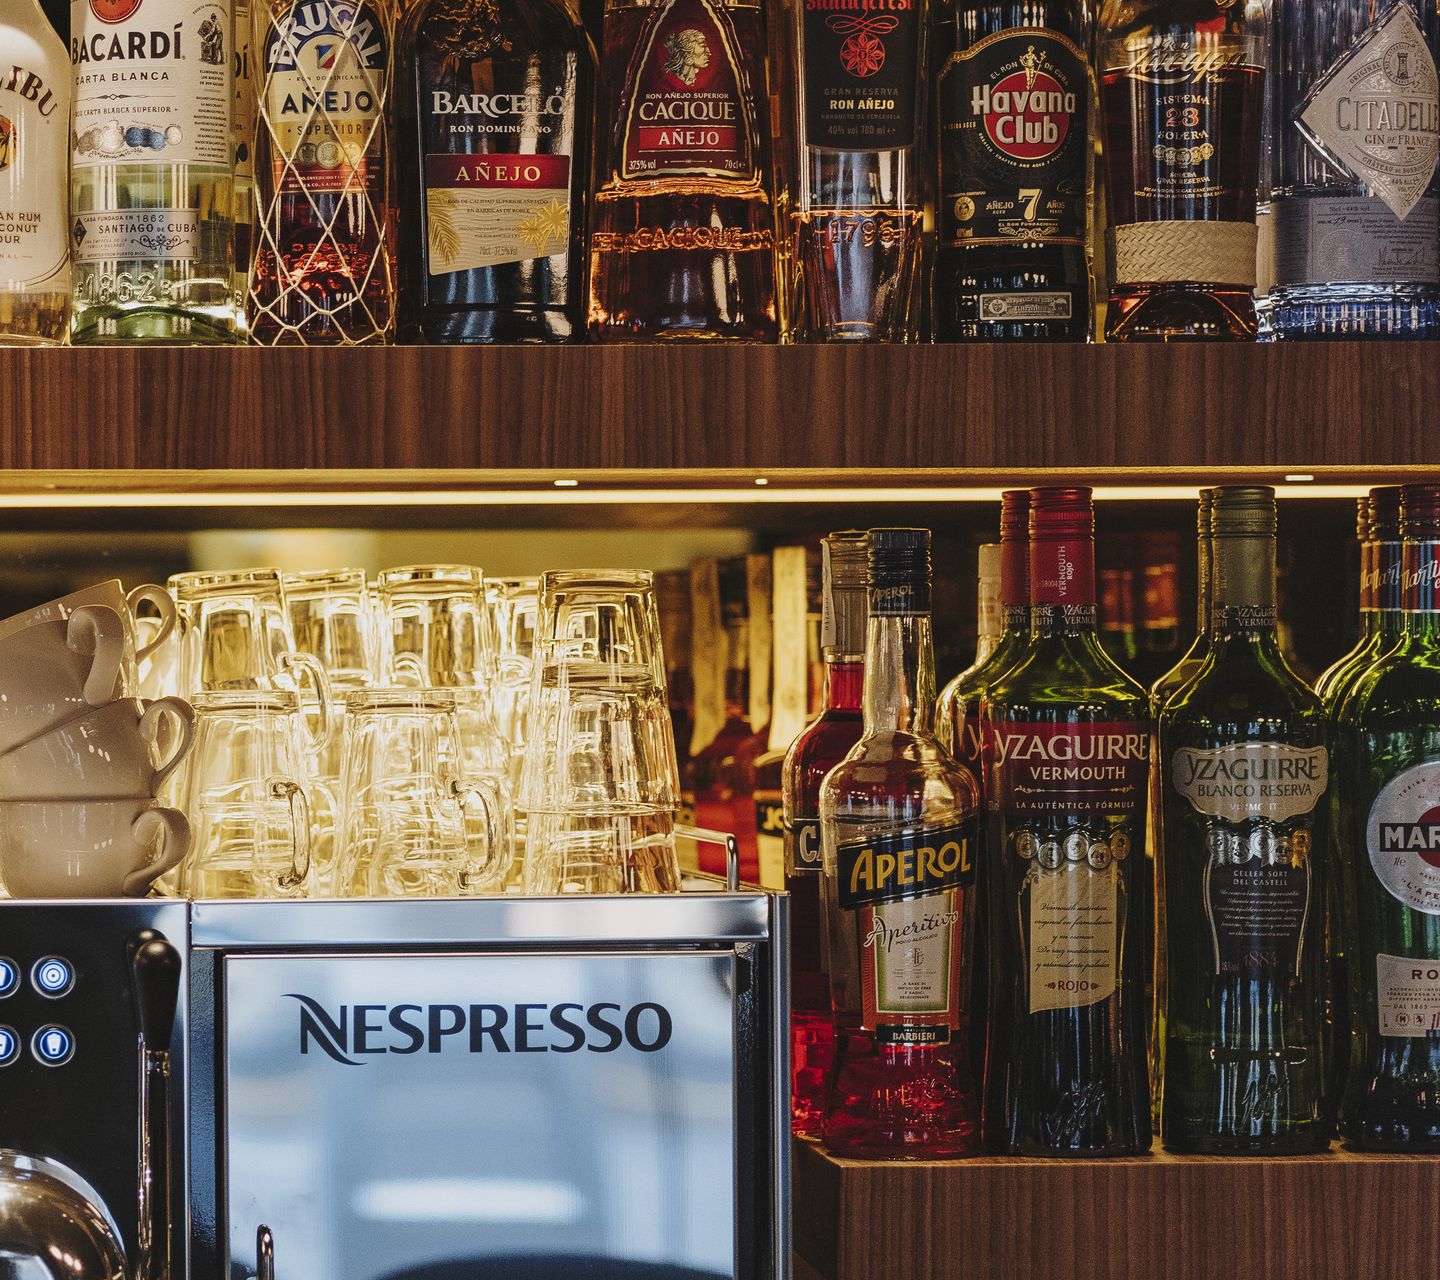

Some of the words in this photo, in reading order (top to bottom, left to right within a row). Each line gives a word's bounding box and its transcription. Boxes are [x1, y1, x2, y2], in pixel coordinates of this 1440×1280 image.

[72, 21, 183, 66] BACARDÍ
[269, 2, 380, 67] BRUGAL
[75, 73, 107, 87] CARTA
[112, 71, 170, 83] BLANCA
[281, 85, 374, 114] AÑEJO
[646, 92, 661, 100] RON
[664, 91, 692, 100] AÑEJO
[829, 99, 855, 110] RON
[857, 97, 896, 110] AÑEJO
[971, 83, 1077, 116] Havana
[639, 101, 736, 121] CACIQUE
[1165, 107, 1199, 128] 23
[450, 124, 474, 134] RON
[658, 128, 721, 146] AÑEJO
[995, 115, 1059, 144] Club
[1364, 134, 1386, 145] GIN
[456, 161, 541, 182] AÑEJO
[985, 200, 1015, 211] AÑEJO
[1017, 187, 1043, 222] 7
[18, 213, 41, 223] RUM
[136, 214, 165, 224] 1862
[99, 224, 154, 235] SANTIAGO
[167, 221, 198, 233] CUBA
[1058, 545, 1066, 597] VERMOUTH
[1066, 562, 1074, 580] ROJO
[993, 729, 1149, 768] YZAGUIRRE
[1030, 765, 1126, 781] VERMOUTH
[1184, 754, 1321, 786] YZAGUIRRE
[1198, 784, 1256, 798] BLANCO
[1260, 783, 1313, 797] RESERVA
[1015, 800, 1027, 810] LA
[1030, 799, 1091, 810] AUTÉNTICA
[1095, 799, 1136, 810] FÓRMULA
[850, 837, 972, 894] APEROL
[863, 910, 959, 953] Aperitivo
[1057, 980, 1089, 993] ROJO
[281, 993, 673, 1066] NESPRESSO
[891, 1031, 937, 1041] BARBIERI
